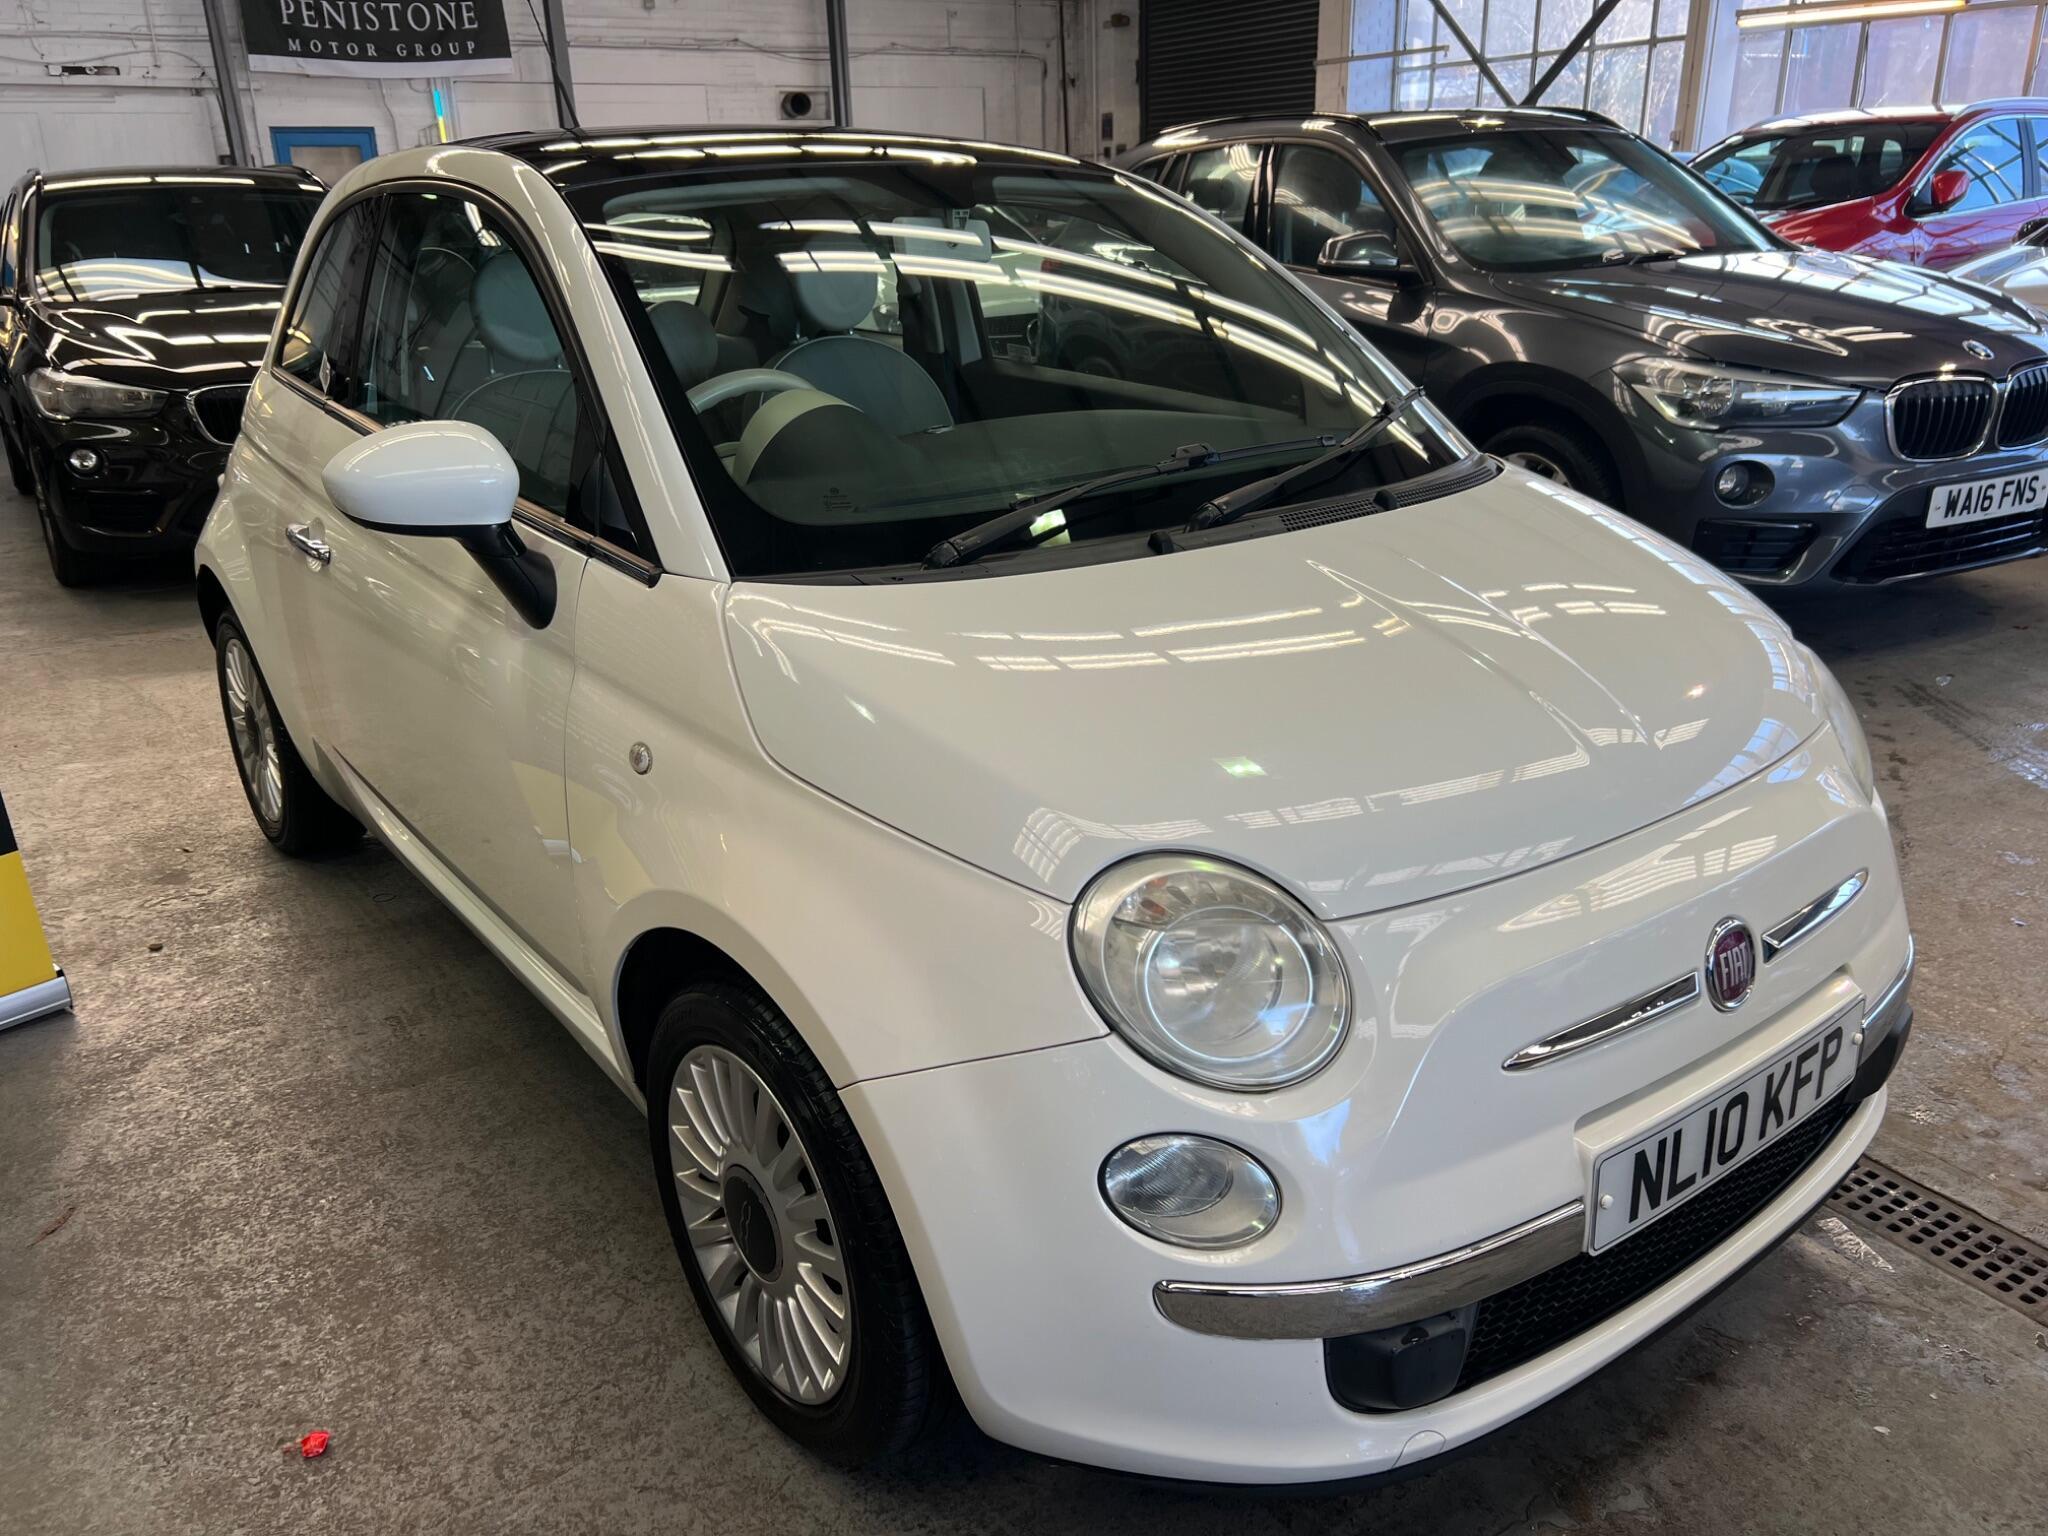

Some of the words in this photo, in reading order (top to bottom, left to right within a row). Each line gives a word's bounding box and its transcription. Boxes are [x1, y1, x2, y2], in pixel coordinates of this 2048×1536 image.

[280, 0, 479, 32] PENISTONE
[288, 38, 378, 57] MOTOR
[396, 40, 476, 57] GROUP
[1944, 483, 1996, 518] WA16
[1998, 475, 2039, 509] FNS
[1719, 941, 1747, 991] FIAT
[1628, 1091, 1749, 1224] NL10
[1758, 1026, 1843, 1141] KFP
